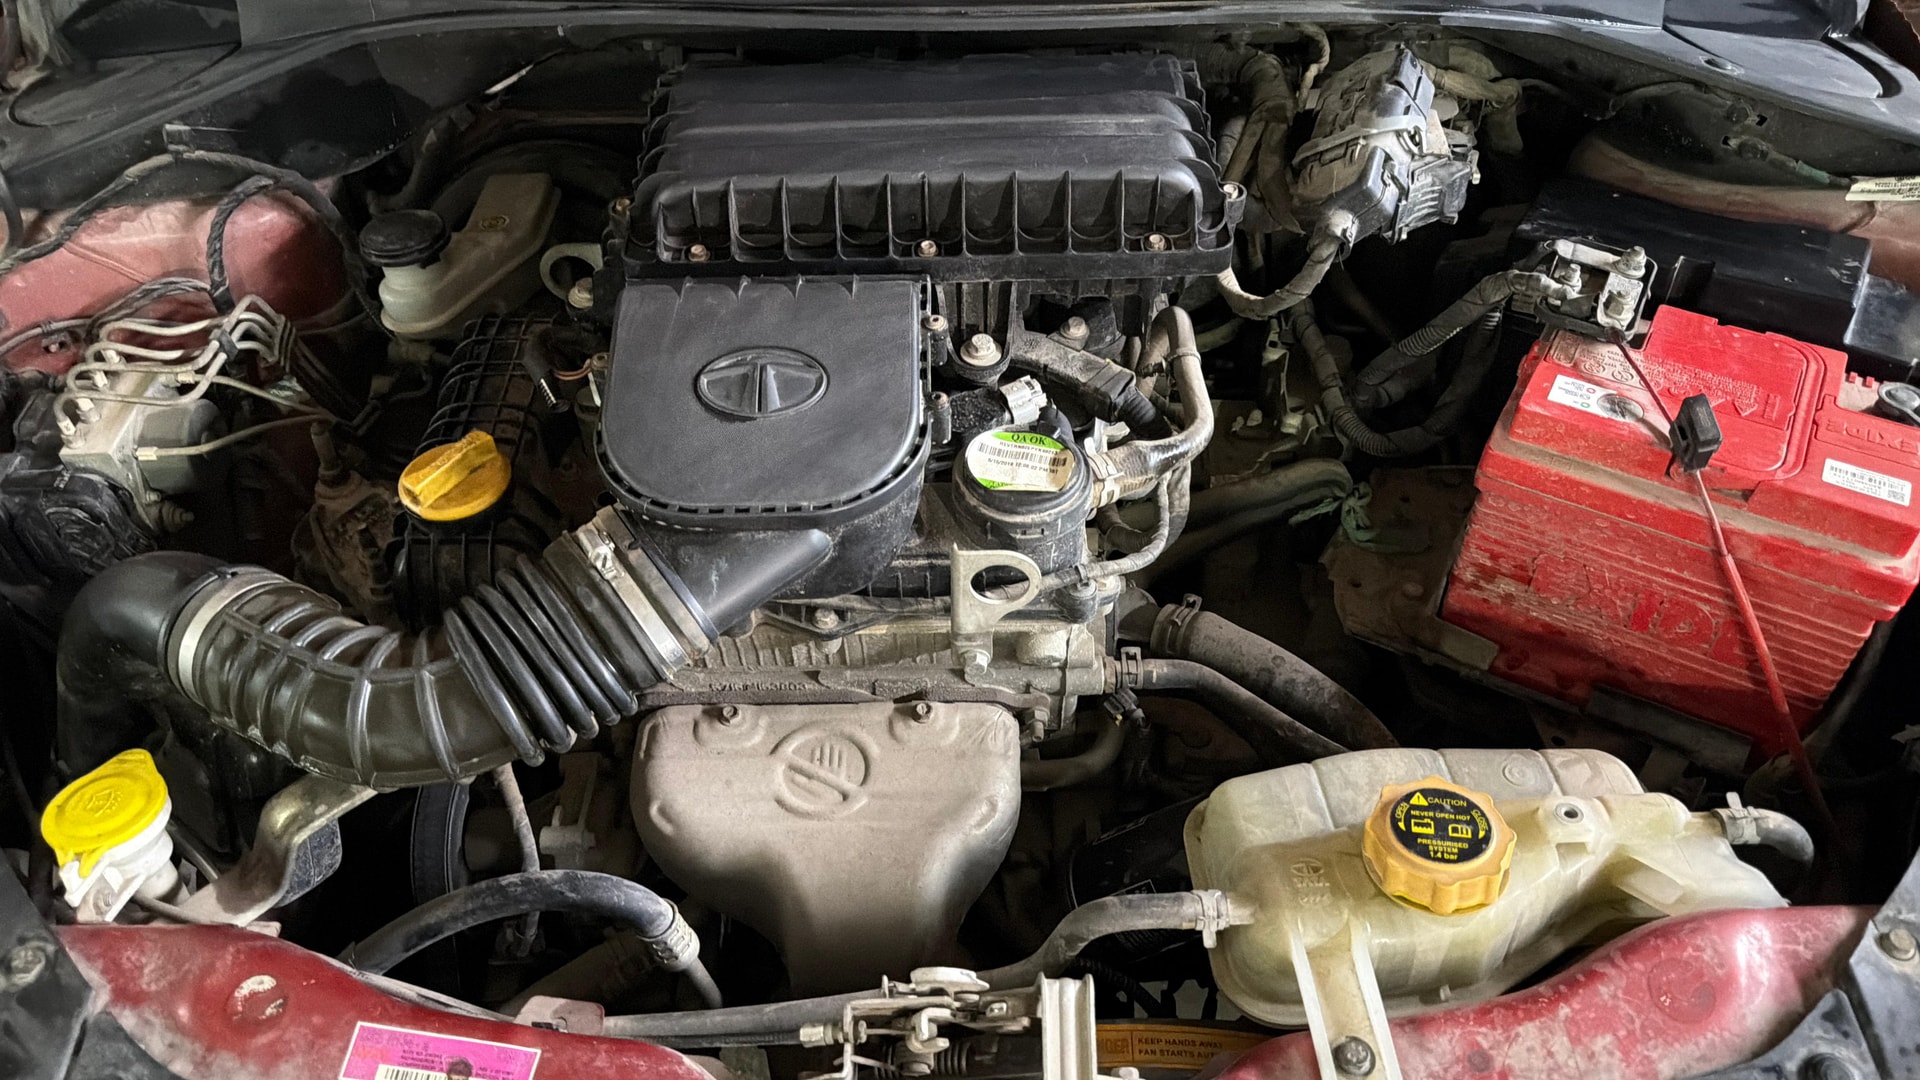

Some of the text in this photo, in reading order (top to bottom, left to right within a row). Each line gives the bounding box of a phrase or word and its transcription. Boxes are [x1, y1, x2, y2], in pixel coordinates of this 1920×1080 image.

[1011, 433, 1046, 446] QA OK
[1427, 797, 1467, 807] CAUTION
[1395, 801, 1410, 819] OPEN
[1435, 812, 1455, 820] OPEN
[1456, 813, 1471, 821] HOT
[1417, 838, 1469, 849] PRESSURISED
[1429, 846, 1459, 854] SYSTEM
[1444, 852, 1458, 860] bar
[1137, 1037, 1164, 1045] KEEP
[1165, 1038, 1197, 1047] HANDS
[1159, 1049, 1195, 1058] STARTS
